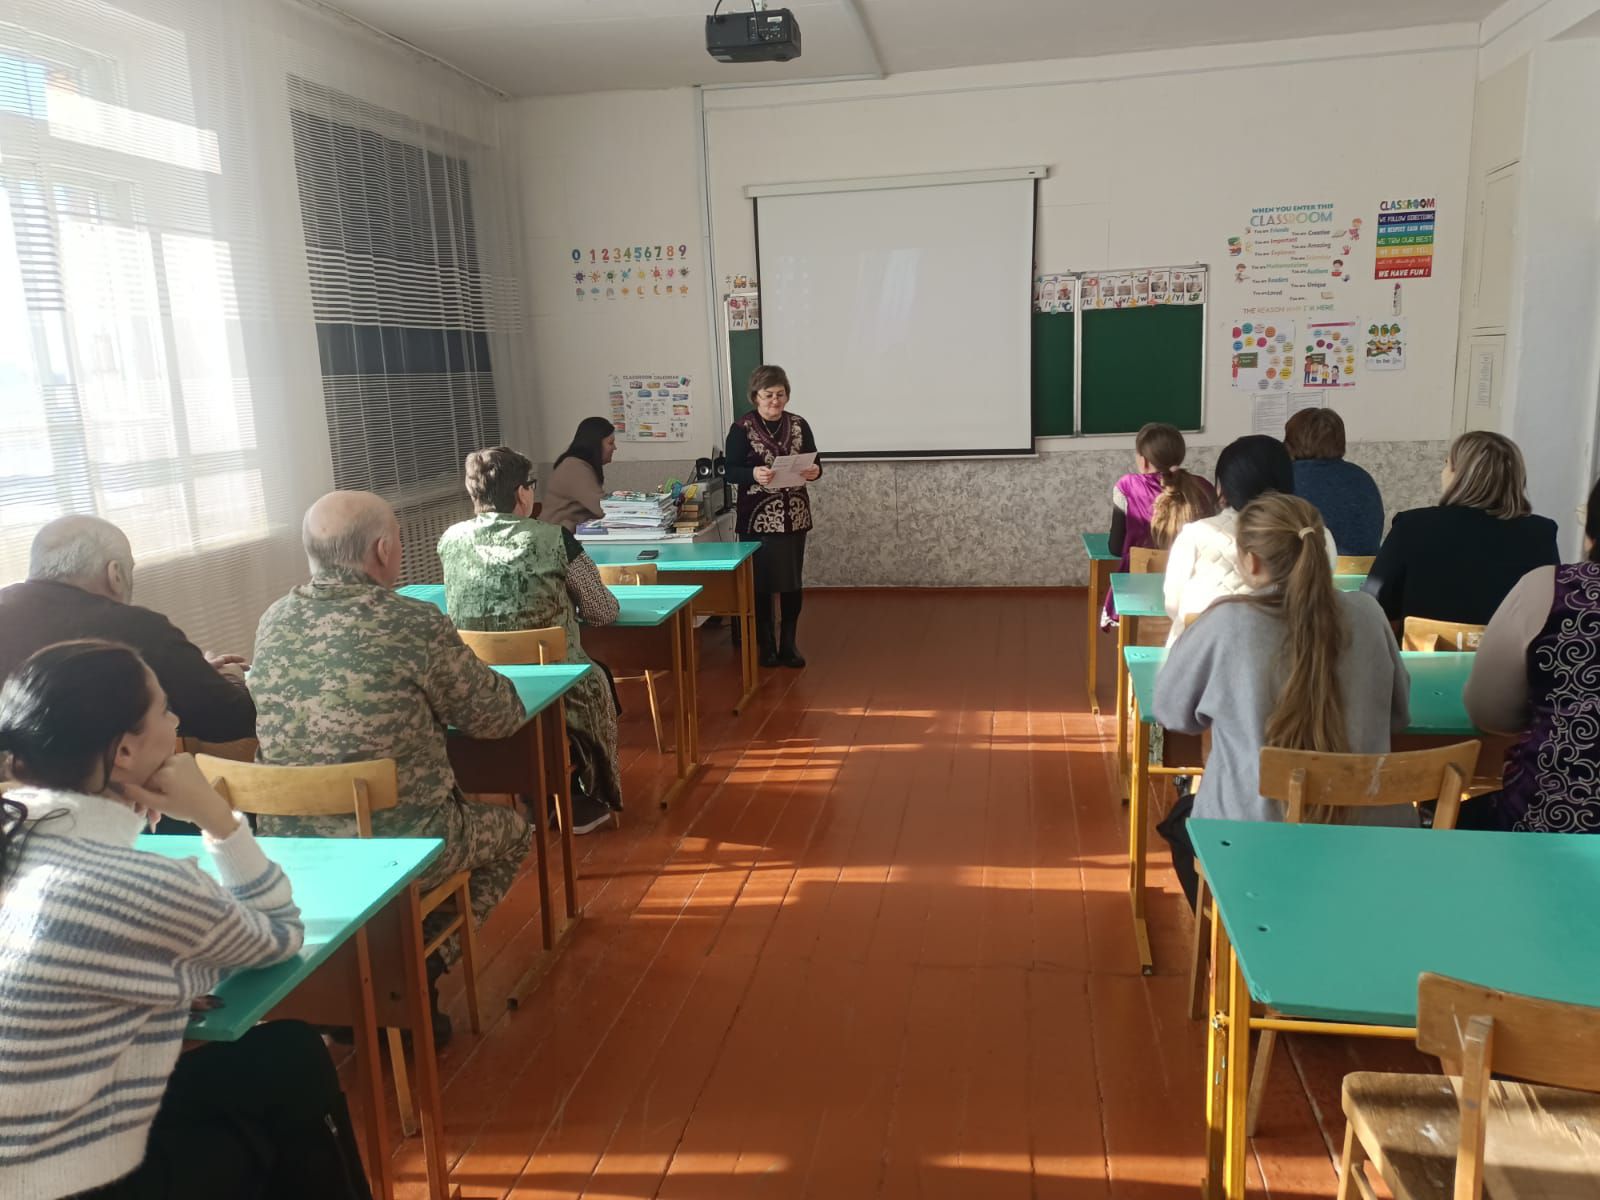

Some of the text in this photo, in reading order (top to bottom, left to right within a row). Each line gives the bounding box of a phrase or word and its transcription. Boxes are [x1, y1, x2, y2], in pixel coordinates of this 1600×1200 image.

[1380, 198, 1435, 210] CLASSROOM
[1250, 211, 1332, 227] CLASSROOM
[571, 248, 581, 261] 0
[589, 249, 596, 261] 1
[601, 249, 610, 260] 2
[613, 248, 621, 260] 3
[623, 247, 632, 259] 4
[634, 247, 642, 259] 5
[644, 246, 652, 258] 6
[654, 246, 662, 258] 7
[666, 245, 674, 257] 8
[678, 244, 686, 256] 9
[1409, 268, 1424, 276] FUN
